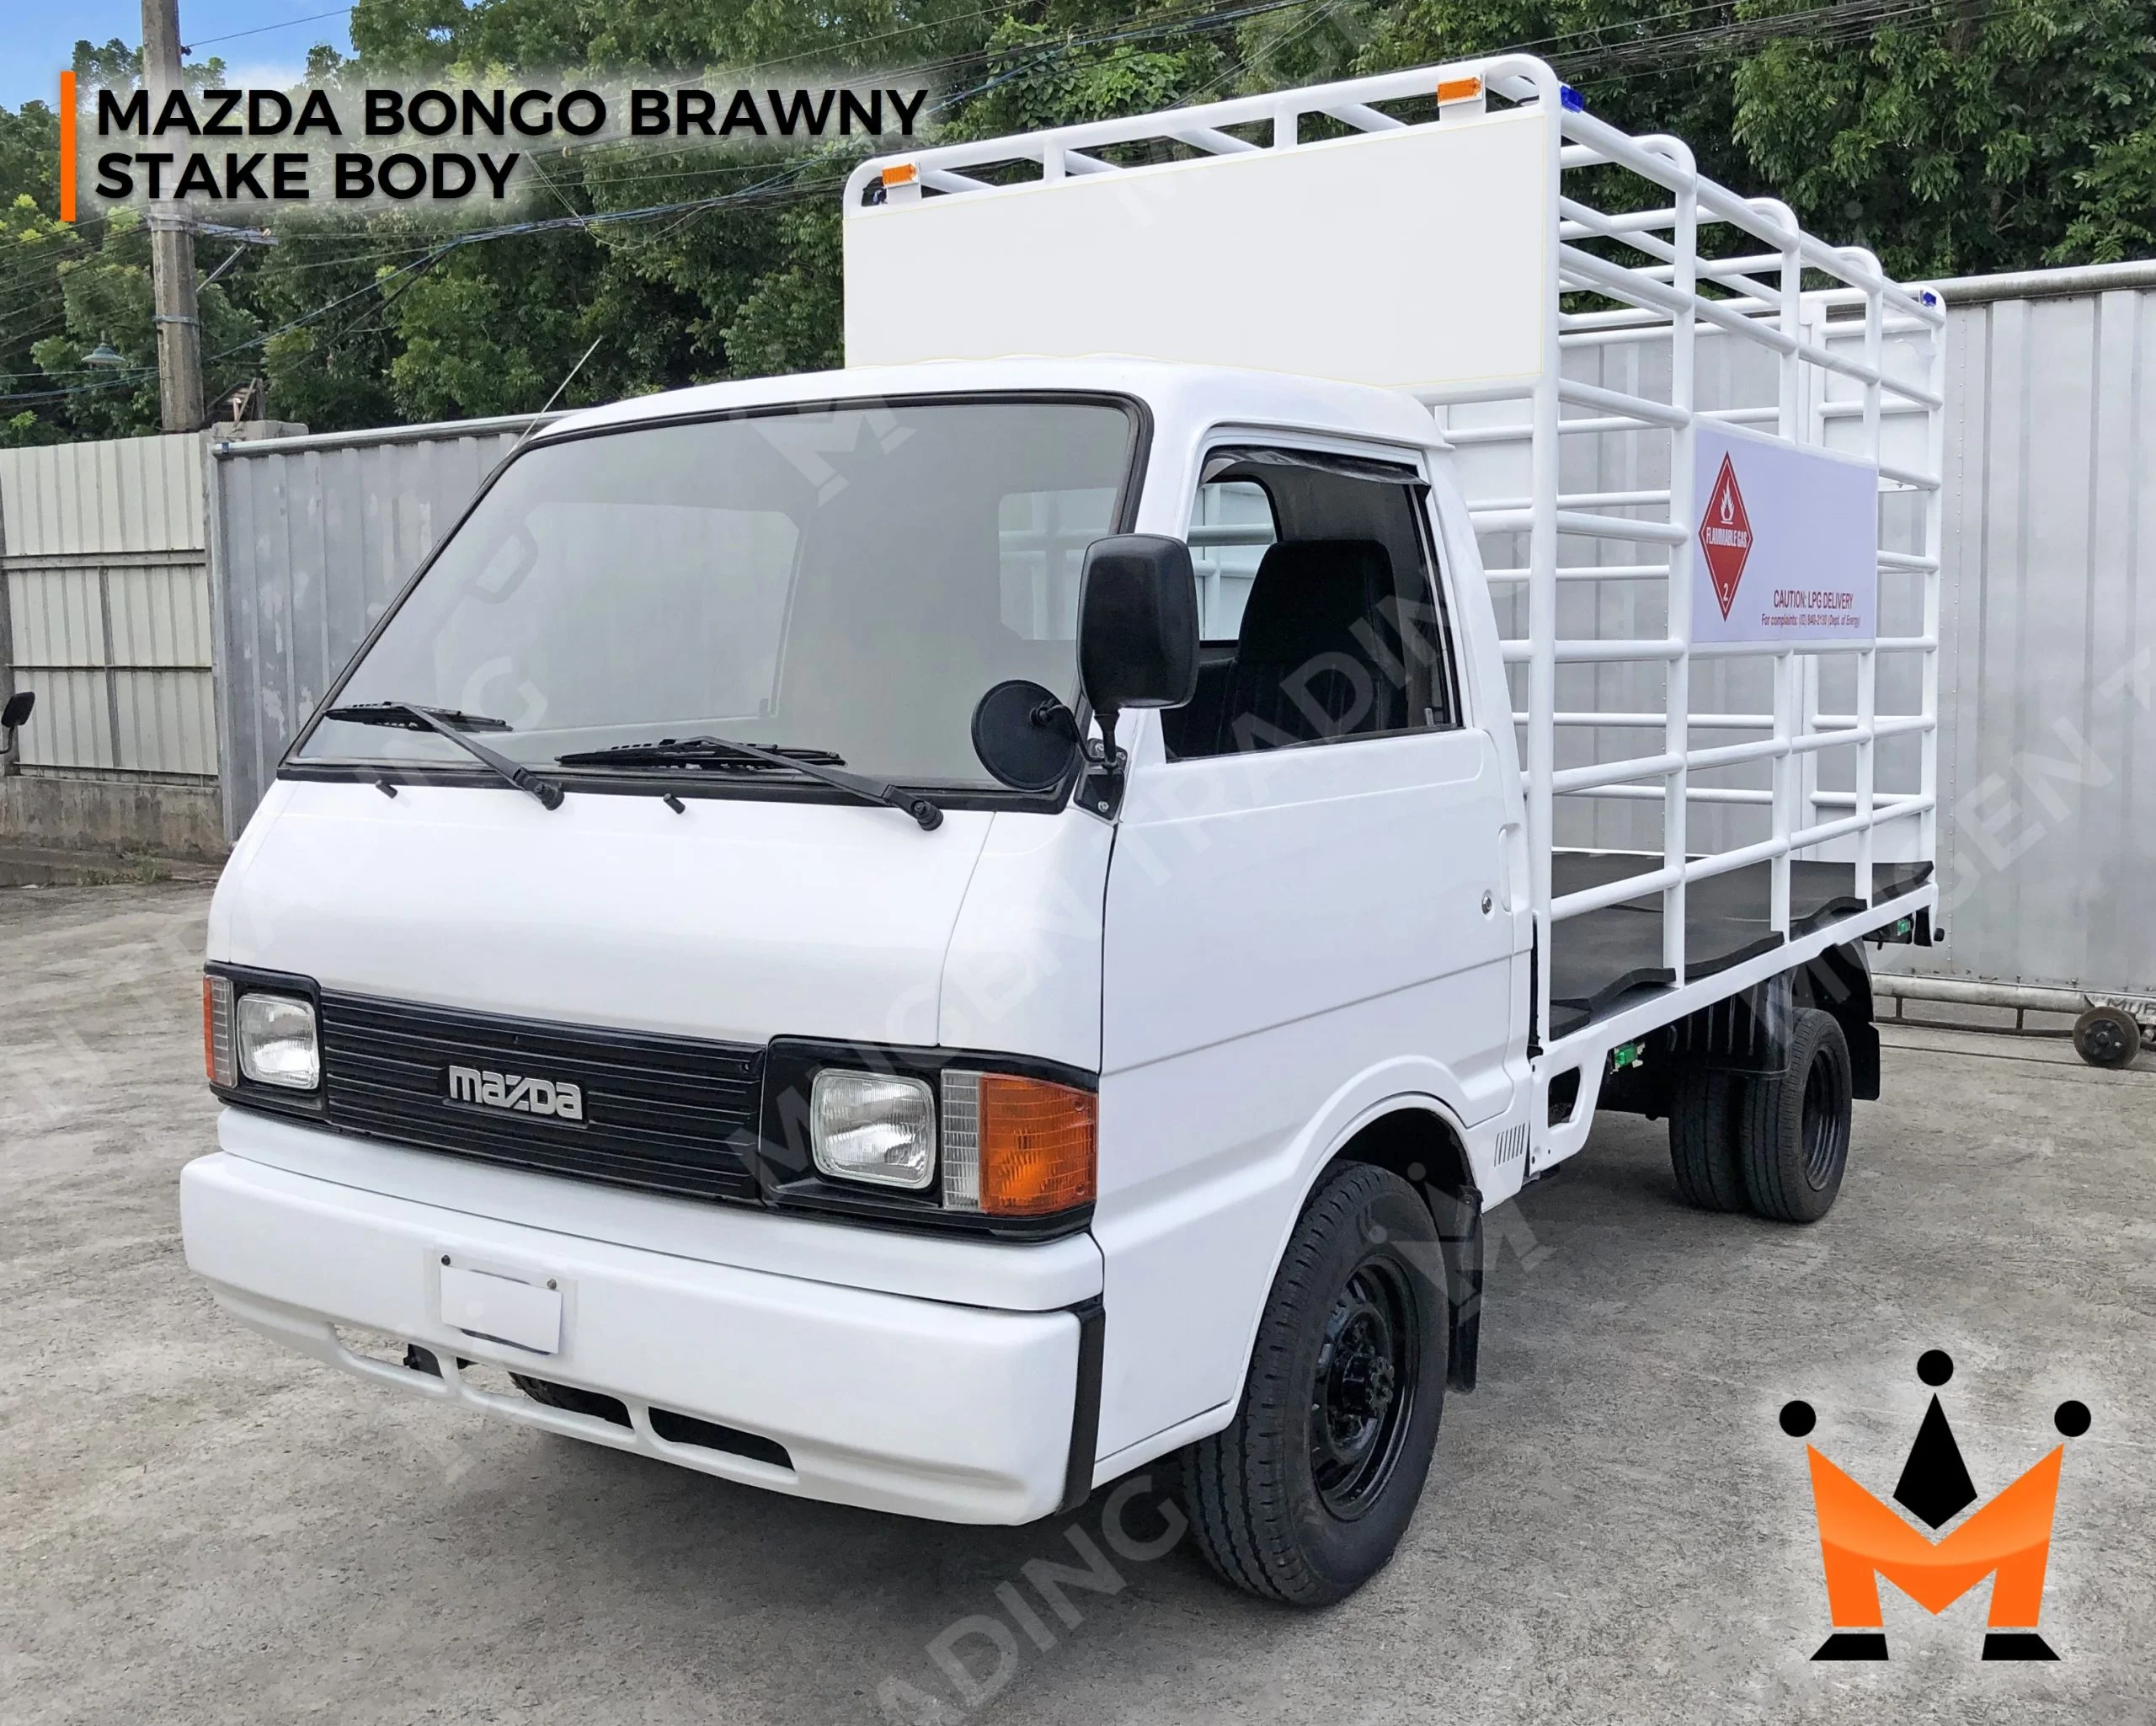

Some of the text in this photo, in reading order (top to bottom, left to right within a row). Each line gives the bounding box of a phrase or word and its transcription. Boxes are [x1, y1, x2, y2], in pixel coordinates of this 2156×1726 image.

[1706, 526, 1748, 548] FLAMMABLE GAS
[1722, 582, 1729, 601] 2
[1774, 590, 1854, 609] CAUTION: LPG DELIVERY
[1761, 613, 1769, 626] For
[1770, 613, 1798, 629] complaints:
